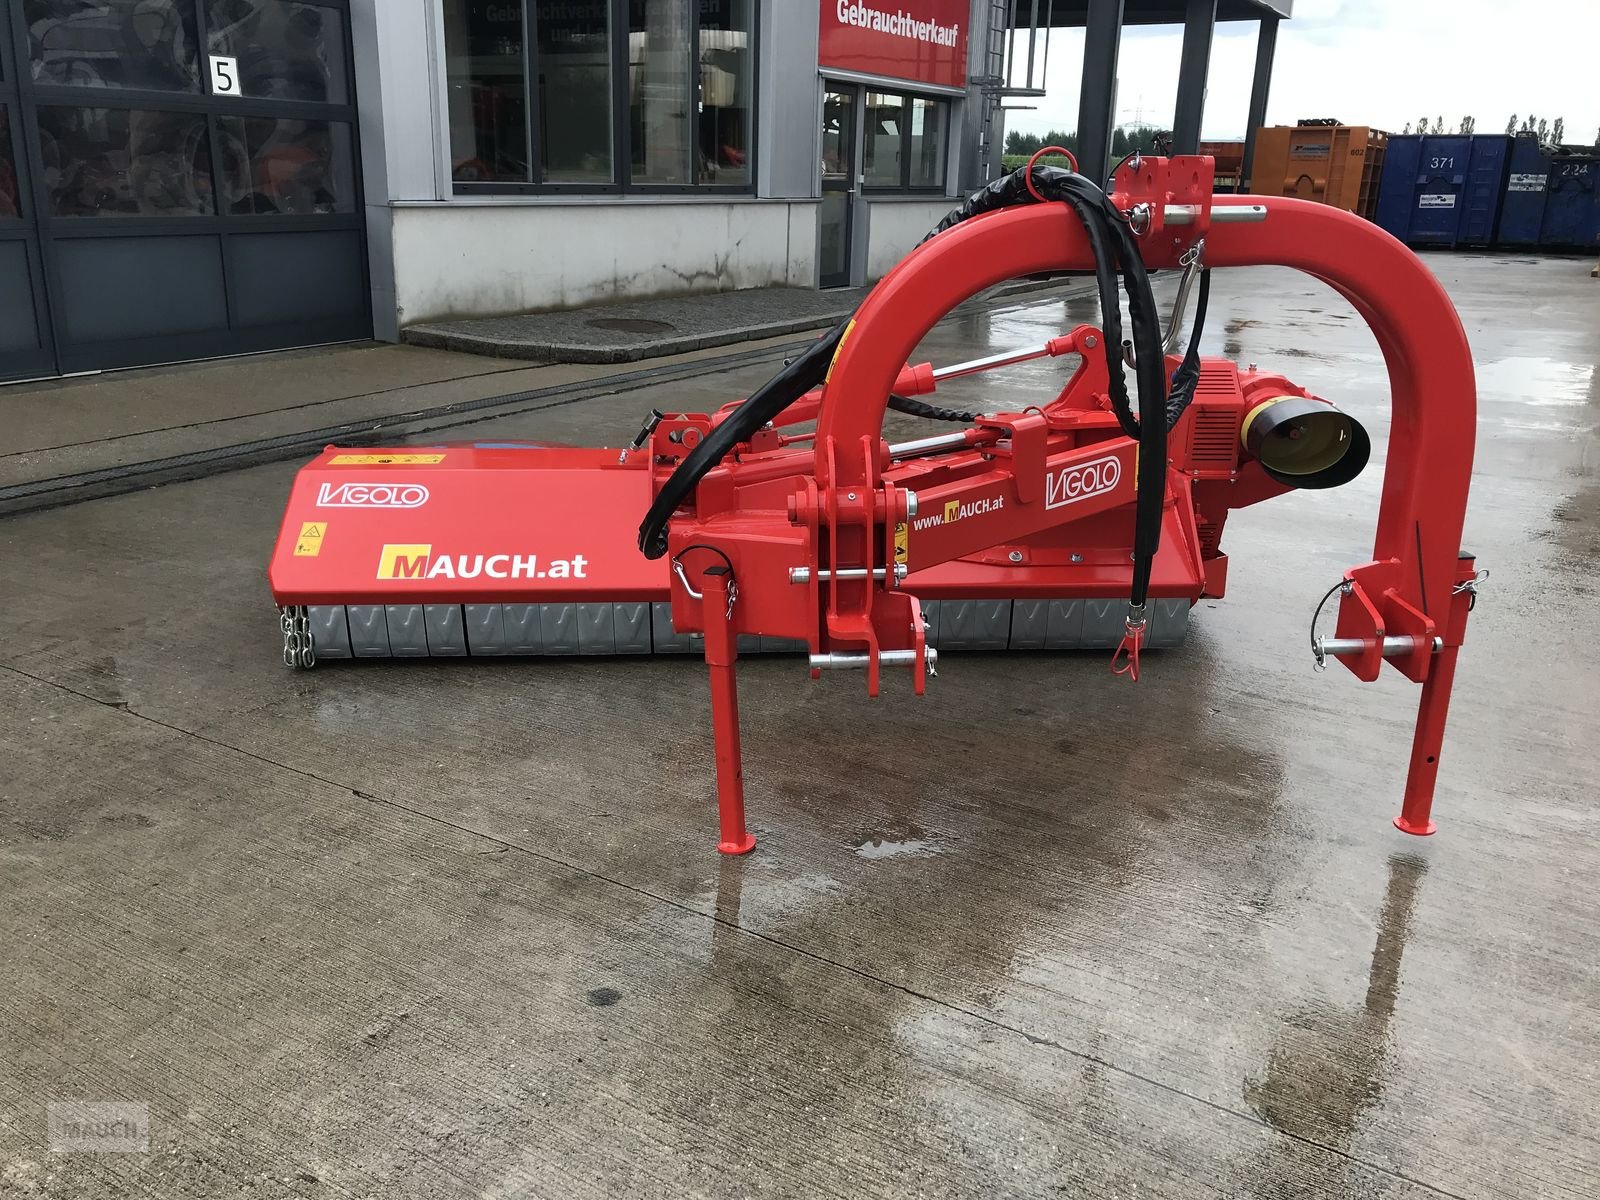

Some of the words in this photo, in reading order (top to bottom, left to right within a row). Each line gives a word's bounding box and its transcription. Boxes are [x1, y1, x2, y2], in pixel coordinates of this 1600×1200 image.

[837, 0, 958, 47] Gebrauchtverkauf
[216, 61, 233, 92] 5
[1430, 157, 1454, 169] 371
[316, 483, 430, 508] VIGOLO
[1046, 456, 1121, 509] VIGOLO
[913, 495, 1004, 531] www.MAUCH.at
[386, 550, 589, 580] MAUCH.at
